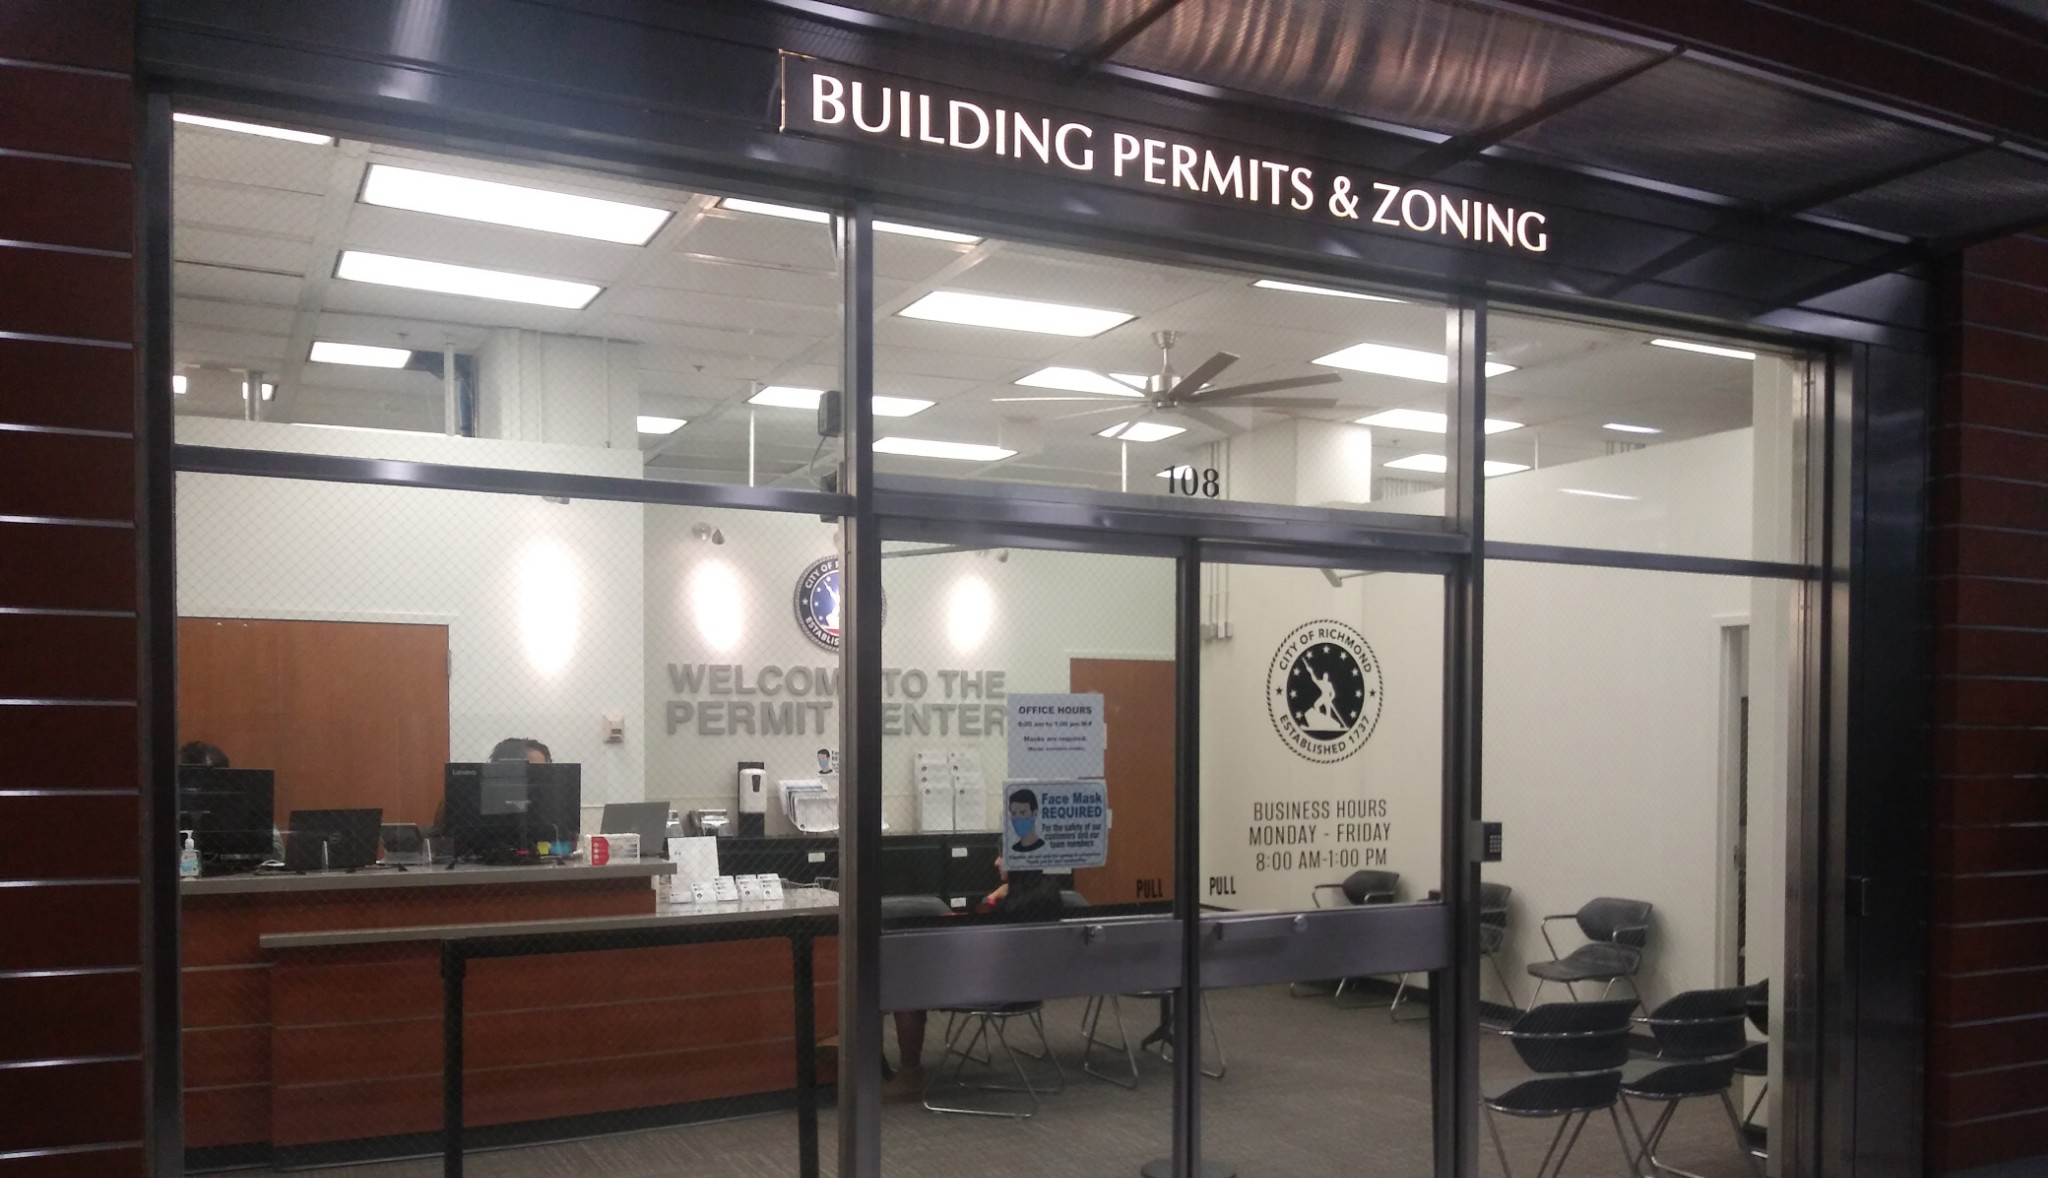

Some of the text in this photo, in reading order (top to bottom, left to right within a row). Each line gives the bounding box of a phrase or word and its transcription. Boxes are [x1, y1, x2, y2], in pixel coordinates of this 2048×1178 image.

[812, 73, 1548, 252] BUILDING PERMITS & ZONING
[1164, 465, 1219, 497] 108
[804, 570, 820, 589] CITY
[821, 562, 833, 573] OF
[805, 616, 839, 646] ESTABLIS
[1279, 628, 1372, 673] CITY OF RICHMOND
[668, 663, 1006, 698] WELCOM TO THE
[667, 701, 1008, 736] PERMIT ENTER
[1018, 706, 1092, 714] OFFICE HOURS
[1279, 714, 1370, 755] ESTABLISHED 1737
[1042, 791, 1102, 805] Face Mask
[1042, 806, 1102, 819] REQUIRED
[1253, 799, 1387, 822] BUSINESS HOURS
[1042, 823, 1051, 832] For
[1064, 823, 1082, 833] safety
[1084, 822, 1091, 830] of
[1249, 824, 1317, 846] MONDAY
[1337, 822, 1391, 843] FRIDAY
[1256, 848, 1387, 872] 8:00 AM-1:00 PM
[1136, 878, 1163, 898] PULL
[1209, 876, 1236, 896] PULL
